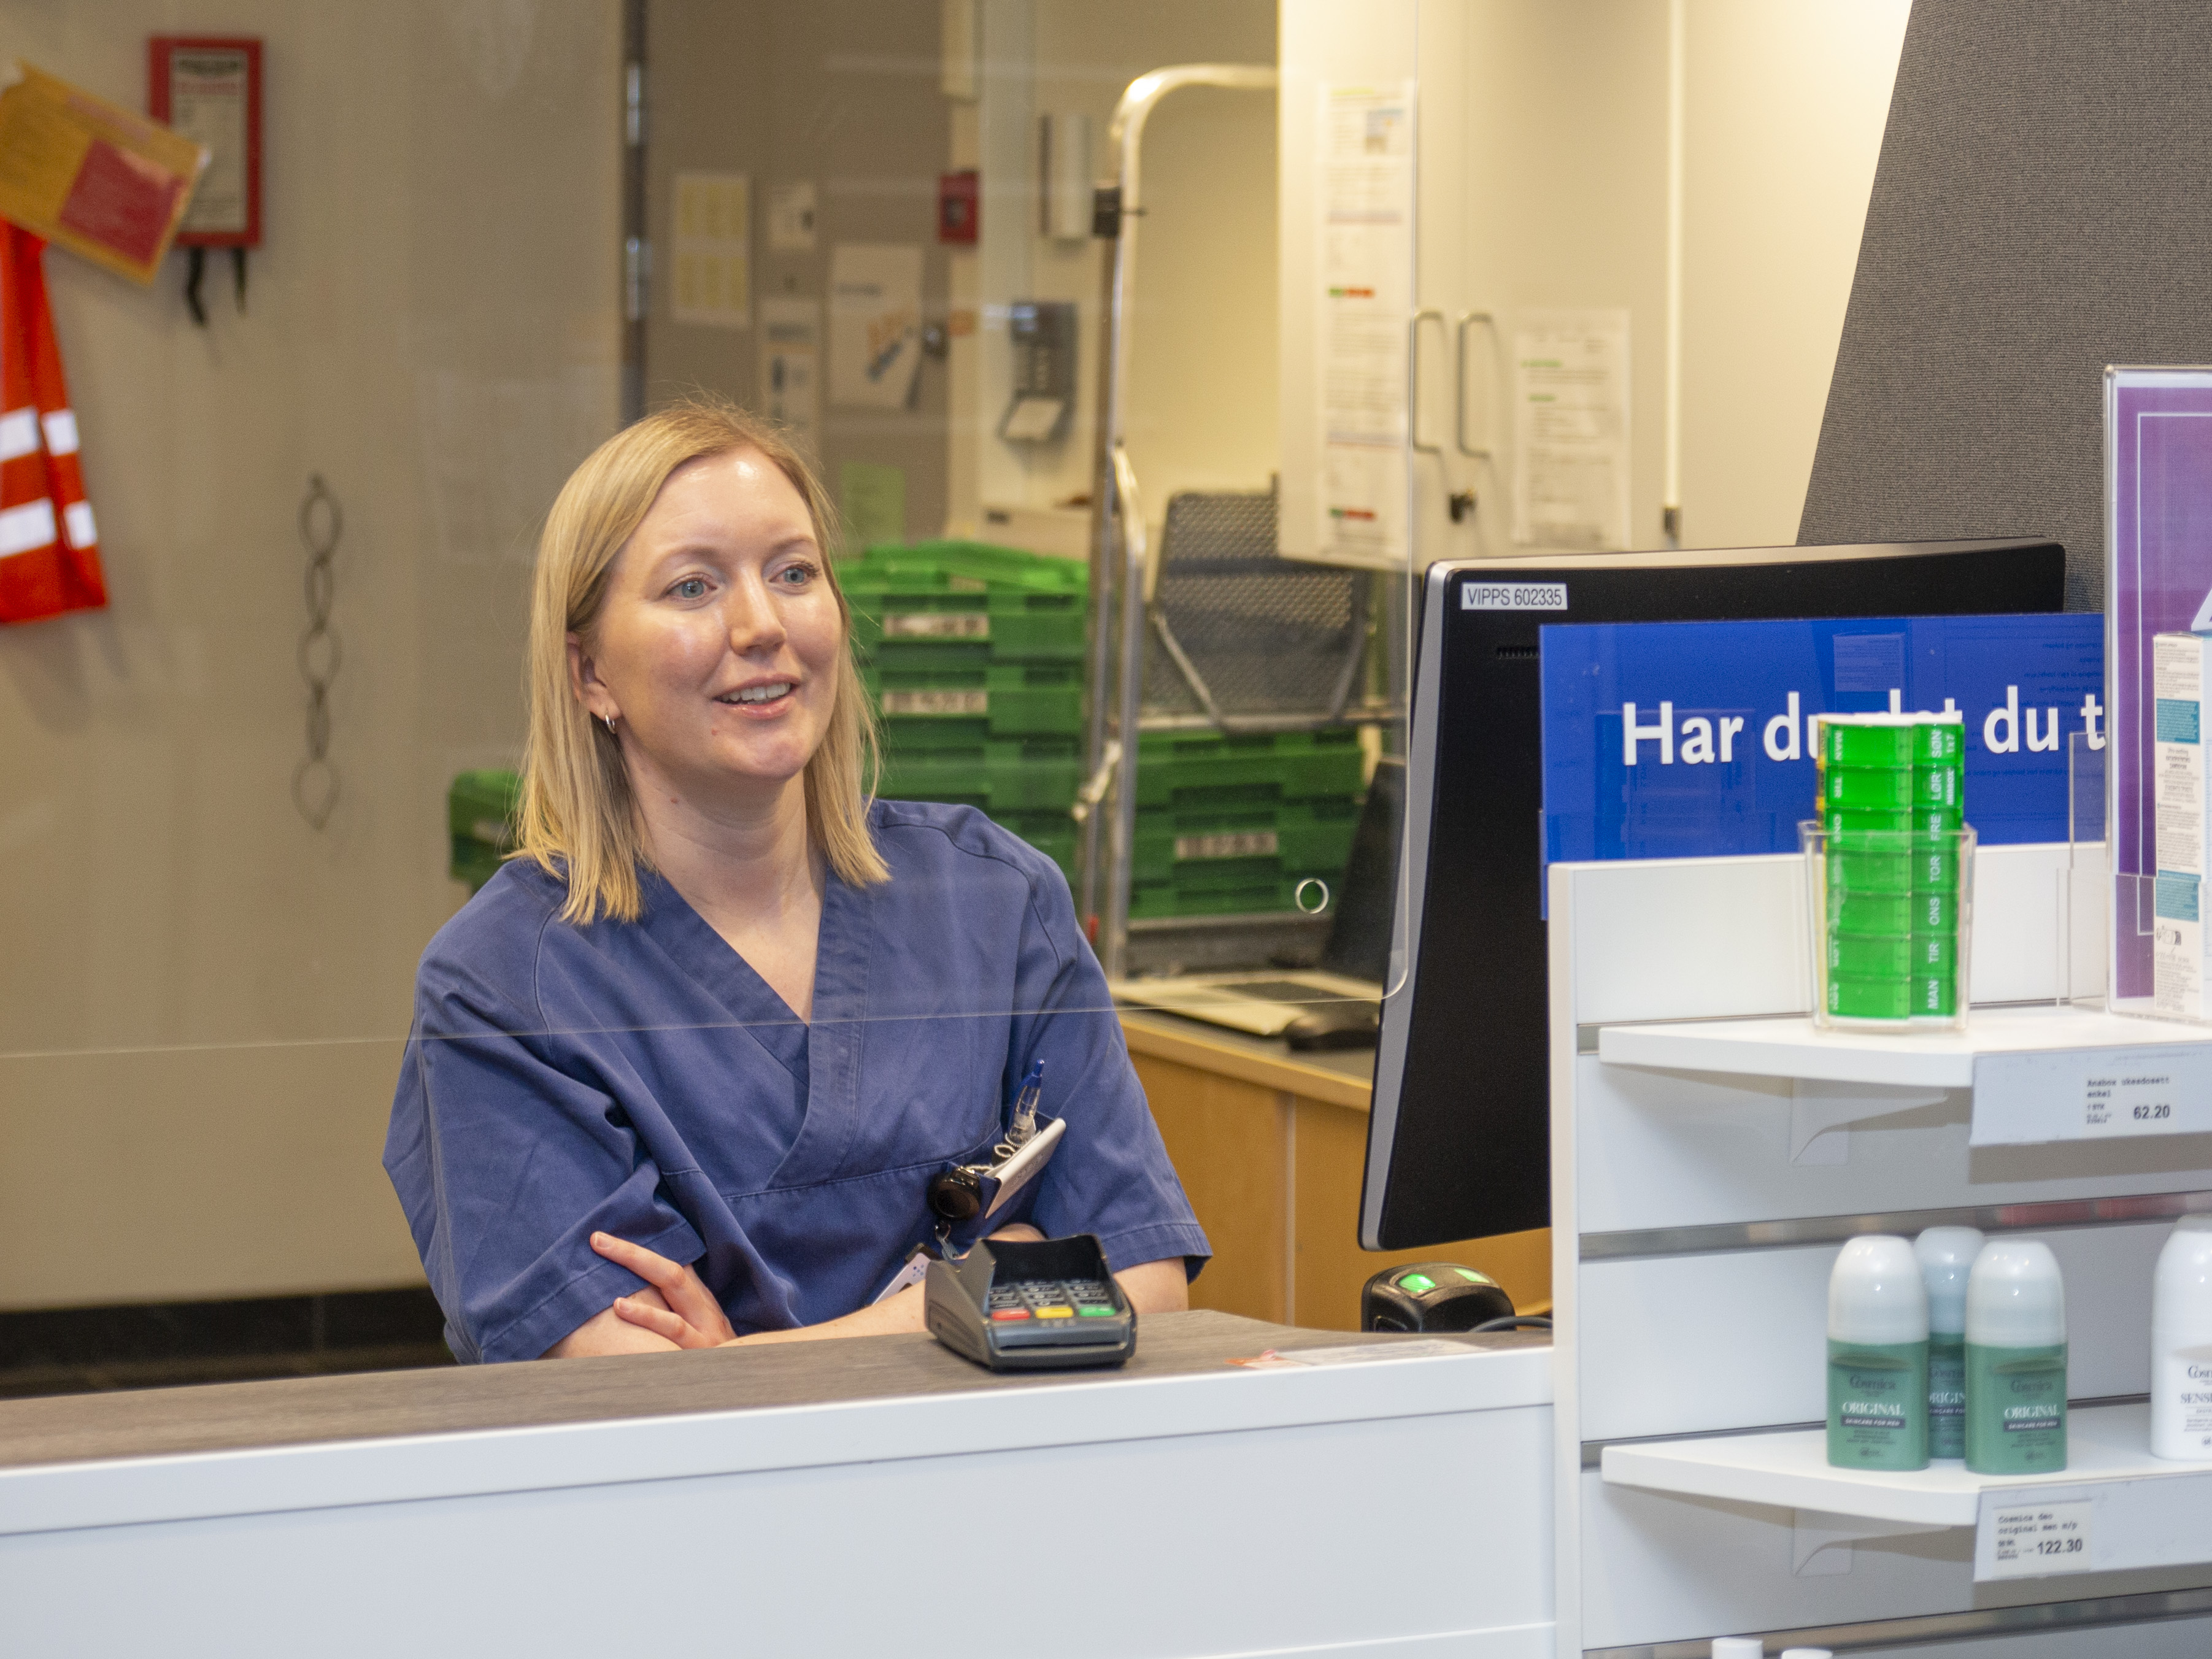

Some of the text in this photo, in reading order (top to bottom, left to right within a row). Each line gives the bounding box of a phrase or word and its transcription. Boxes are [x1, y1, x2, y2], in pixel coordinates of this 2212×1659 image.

[1468, 588, 1562, 606] VIPPS 602335
[1623, 701, 1744, 766] Har
[1983, 685, 2059, 754] du
[1927, 729, 1943, 1010] MAN TIR ONS TOR FRE LØR SØN
[2133, 1105, 2170, 1120] 62.20
[1843, 1401, 1904, 1416] ORIGINAL
[2004, 1404, 2059, 1419] ORIGINAL
[2037, 1538, 2083, 1555] 122.30
